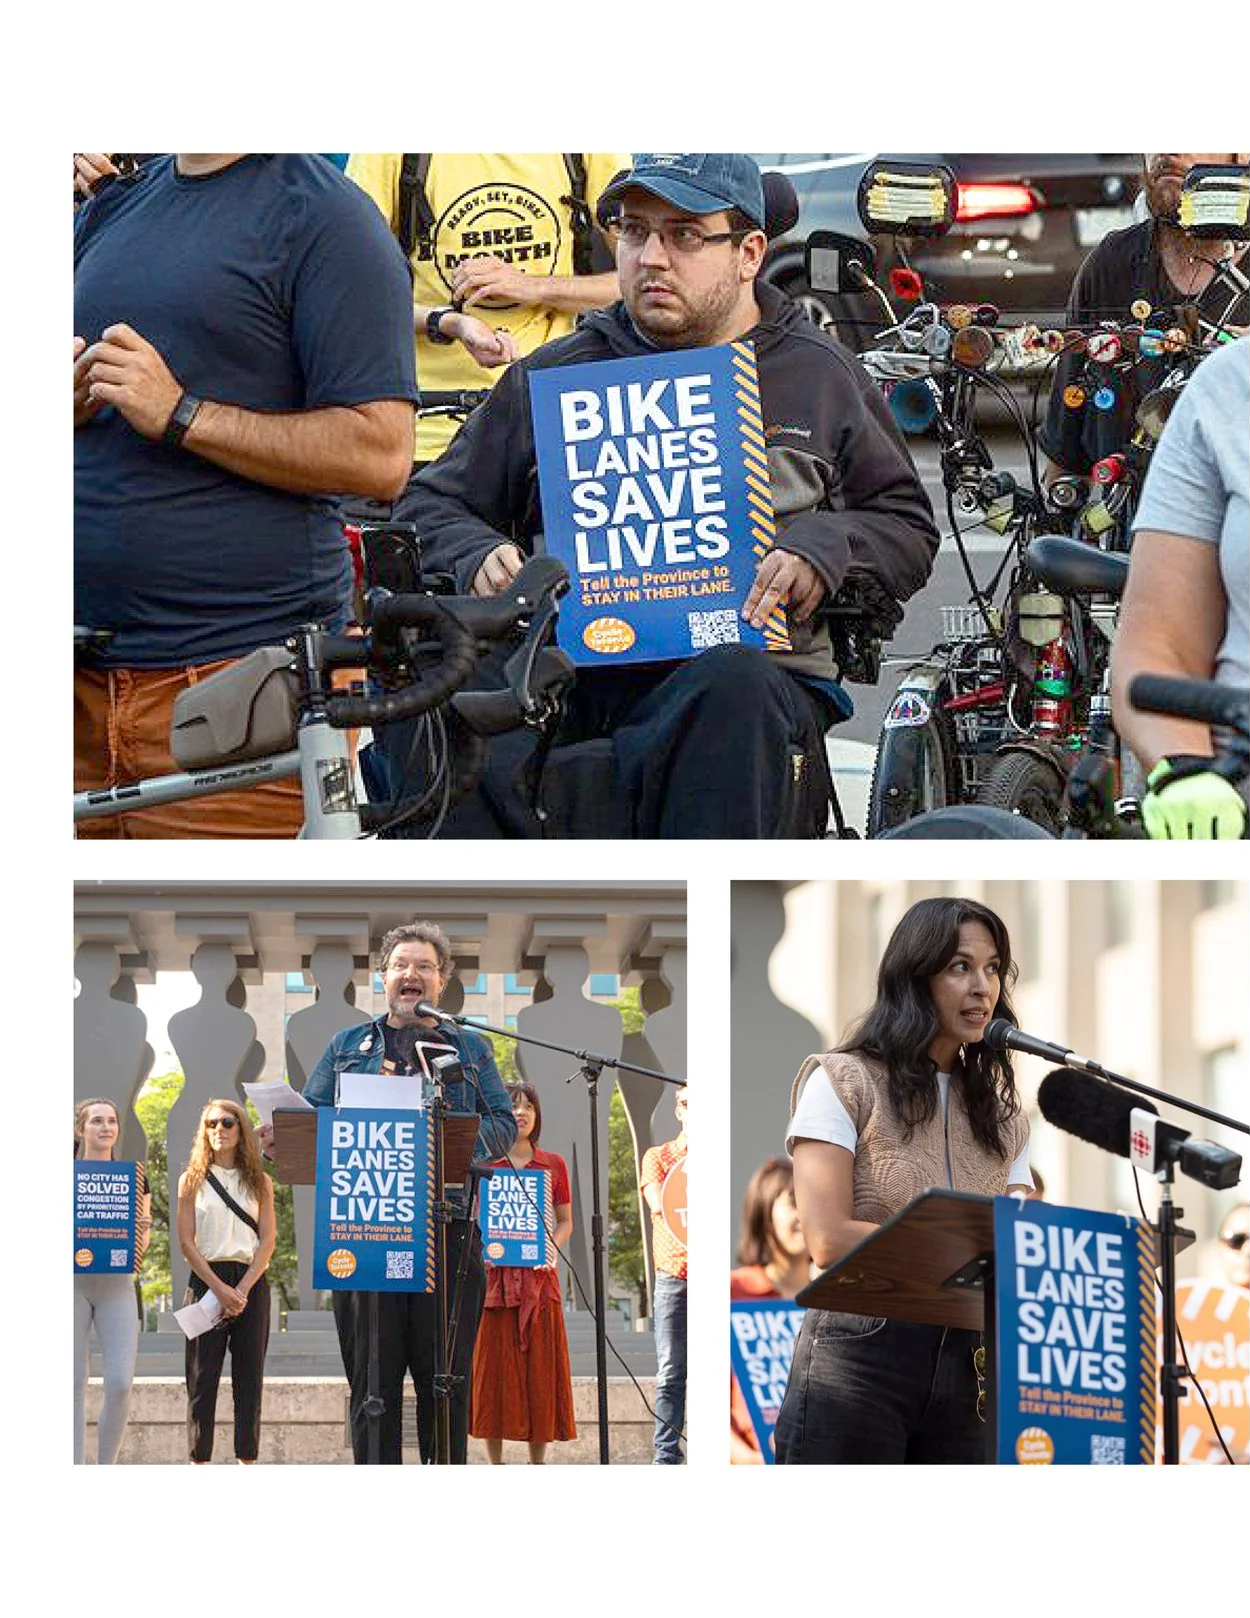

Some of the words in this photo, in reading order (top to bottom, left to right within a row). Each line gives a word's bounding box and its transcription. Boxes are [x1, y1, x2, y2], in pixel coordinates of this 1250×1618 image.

[461, 225, 534, 249] BIKE
[560, 374, 716, 443] BIKE
[565, 428, 719, 480] LANES
[572, 466, 726, 528] SAVE
[575, 515, 730, 572] LIVES
[579, 577, 610, 592] Tell
[613, 574, 639, 588] the
[642, 569, 711, 586] Province
[714, 565, 729, 577] to
[581, 592, 621, 606] STAY
[624, 590, 639, 602] IN
[642, 585, 688, 600] THEIR
[690, 579, 736, 596] LANE.
[332, 1120, 415, 1149] BIKE
[331, 1150, 415, 1170] LANES
[77, 1173, 90, 1181] NO
[112, 1174, 129, 1182] HAS
[77, 1182, 129, 1194] SOLVED
[331, 1170, 415, 1197] SAVE
[488, 1175, 538, 1192] BIKE
[77, 1195, 129, 1203] CONGESTION
[330, 1197, 415, 1222] LIVES
[488, 1191, 538, 1204] LANES
[488, 1202, 538, 1218] SAVE
[77, 1211, 94, 1219] CAR
[97, 1211, 129, 1220] TRAFFIC
[330, 1223, 347, 1232] Tell
[348, 1223, 362, 1232] the
[364, 1224, 401, 1233] Province
[403, 1225, 413, 1233] to
[488, 1216, 538, 1231] LIVES
[330, 1232, 351, 1241] STAY
[353, 1233, 362, 1241] IN
[364, 1233, 389, 1242] THEIR
[1014, 1220, 1125, 1278] BIKE
[1016, 1266, 1125, 1311] LANES
[1017, 1301, 1127, 1353] SAVE
[1017, 1343, 1127, 1392] LIVES
